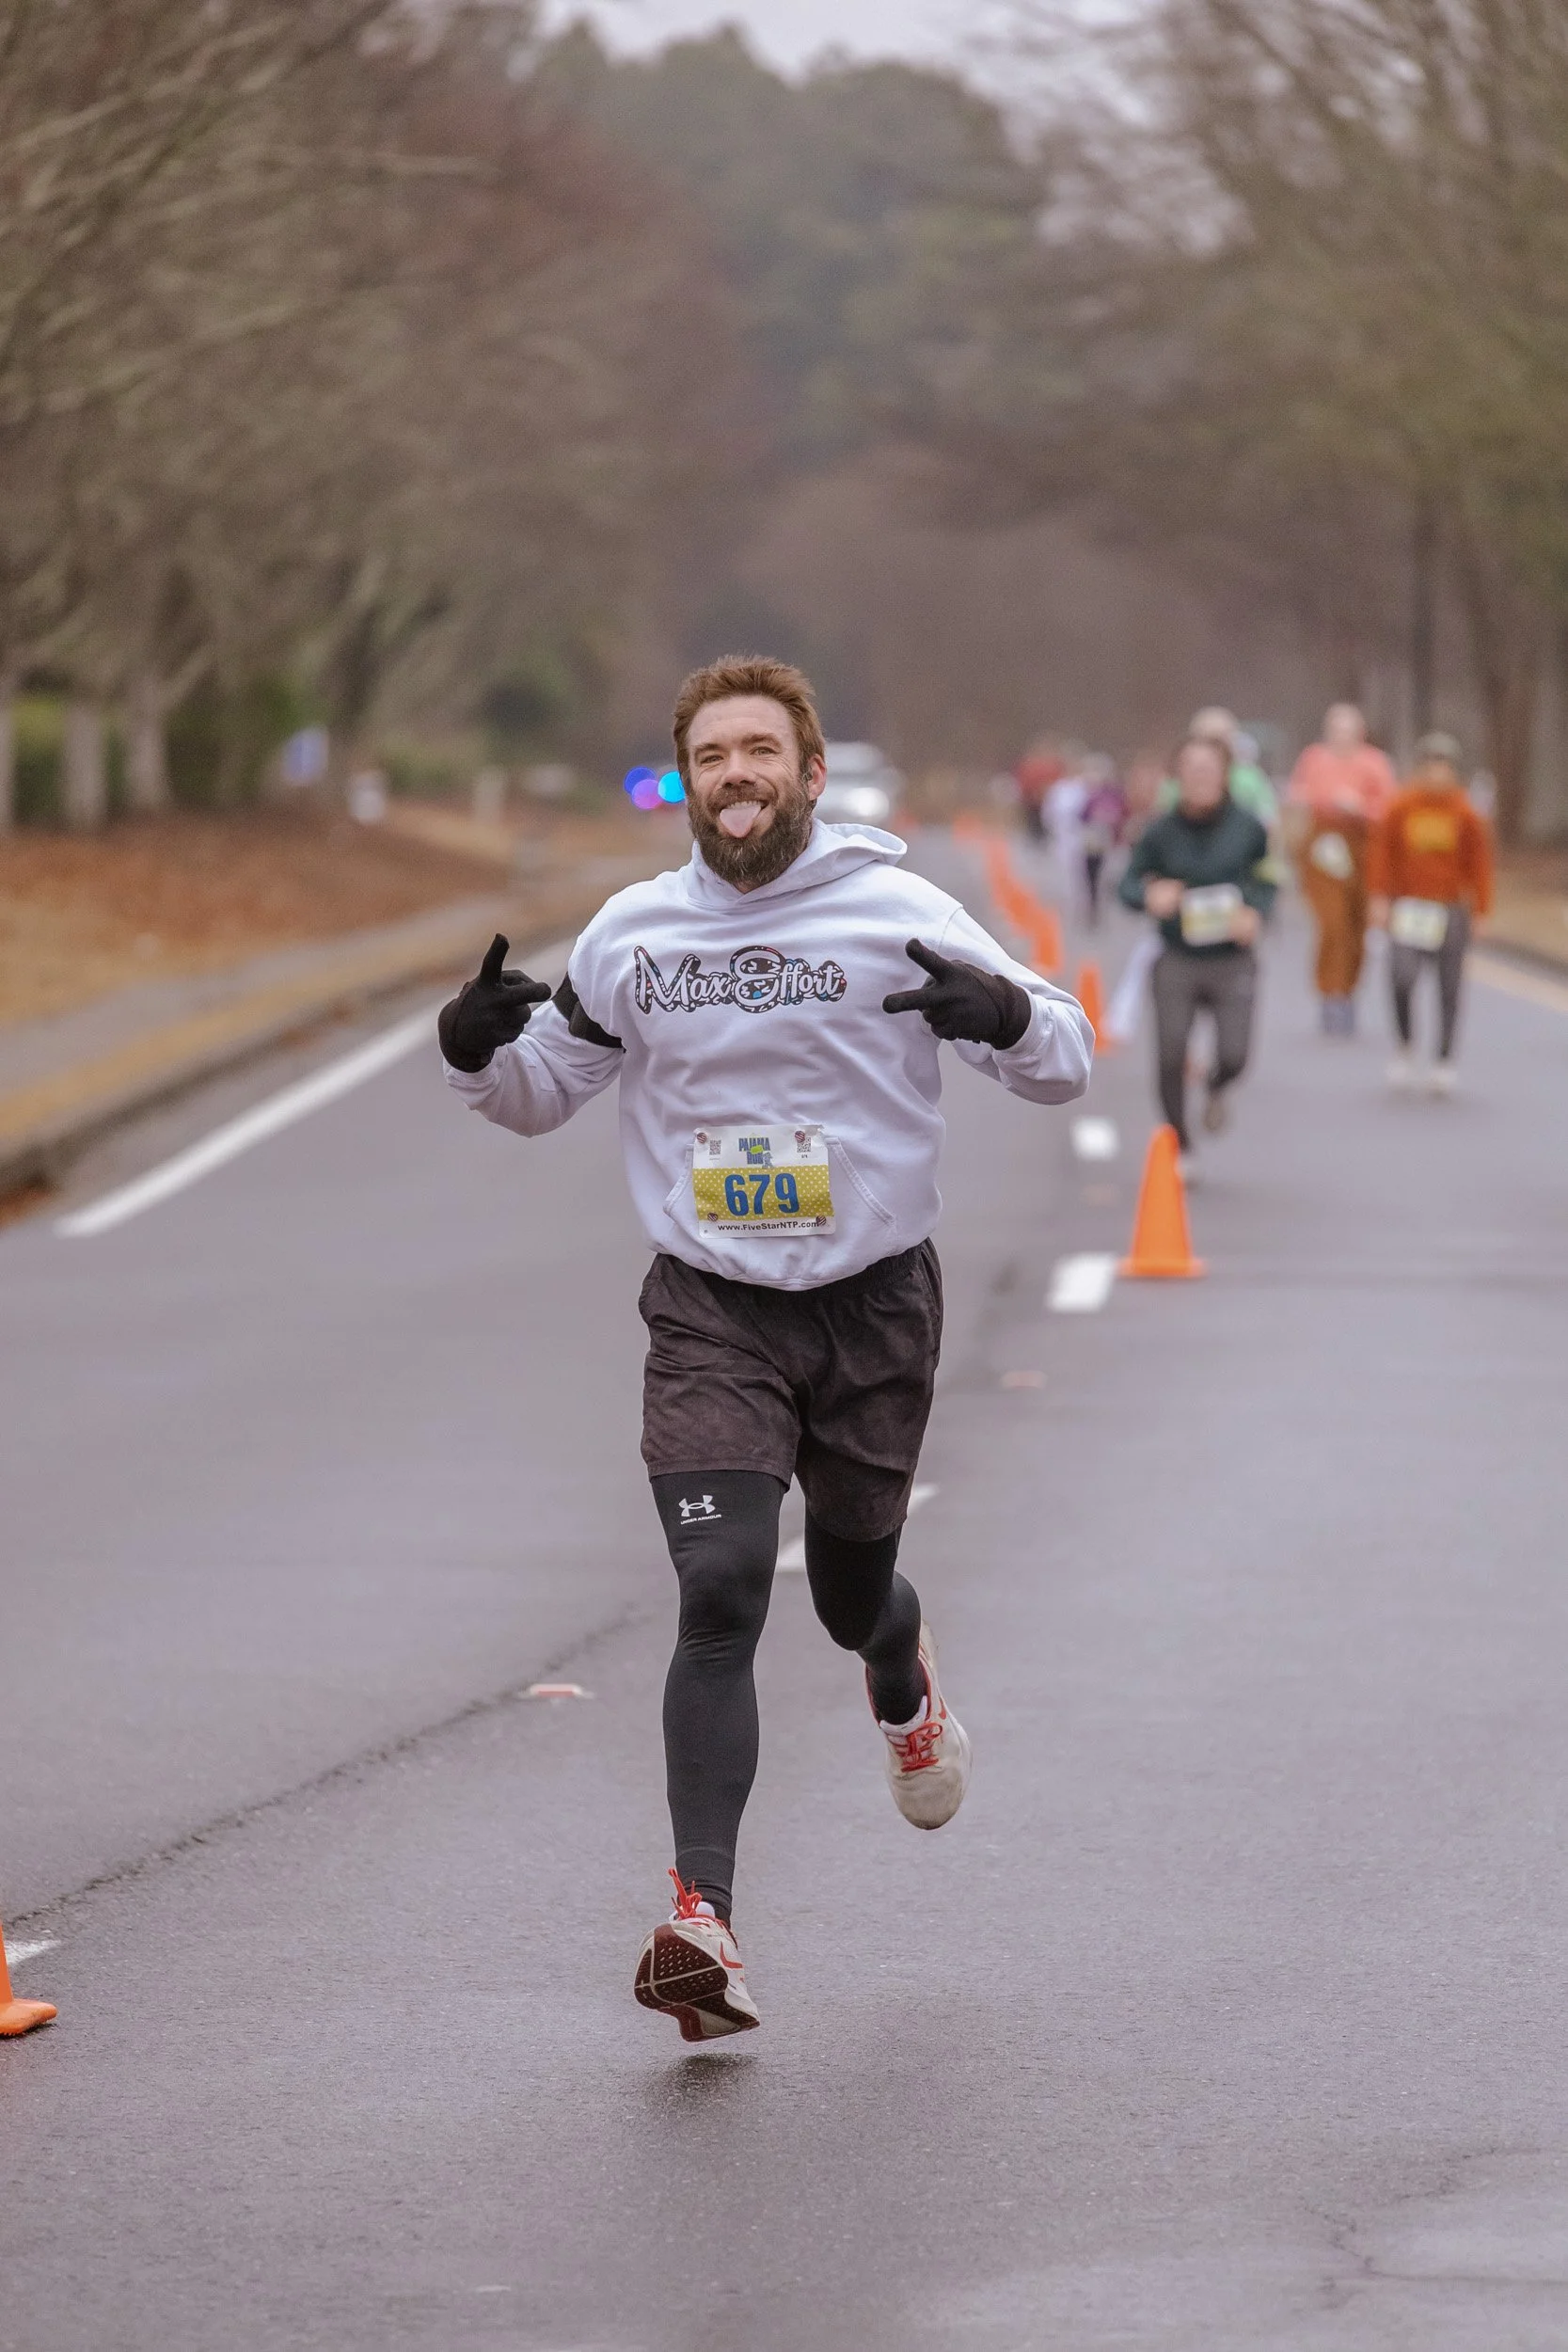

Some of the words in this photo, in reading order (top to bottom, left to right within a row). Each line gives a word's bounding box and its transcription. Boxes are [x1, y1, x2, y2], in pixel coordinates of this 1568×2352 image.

[634, 946, 734, 1014] Max
[730, 946, 847, 1013] Effort
[738, 1137, 771, 1152] PAJAMA
[746, 1150, 764, 1165] RUN
[724, 1173, 800, 1216] 679
[718, 1221, 819, 1232] www.FiveStarNTP.com
